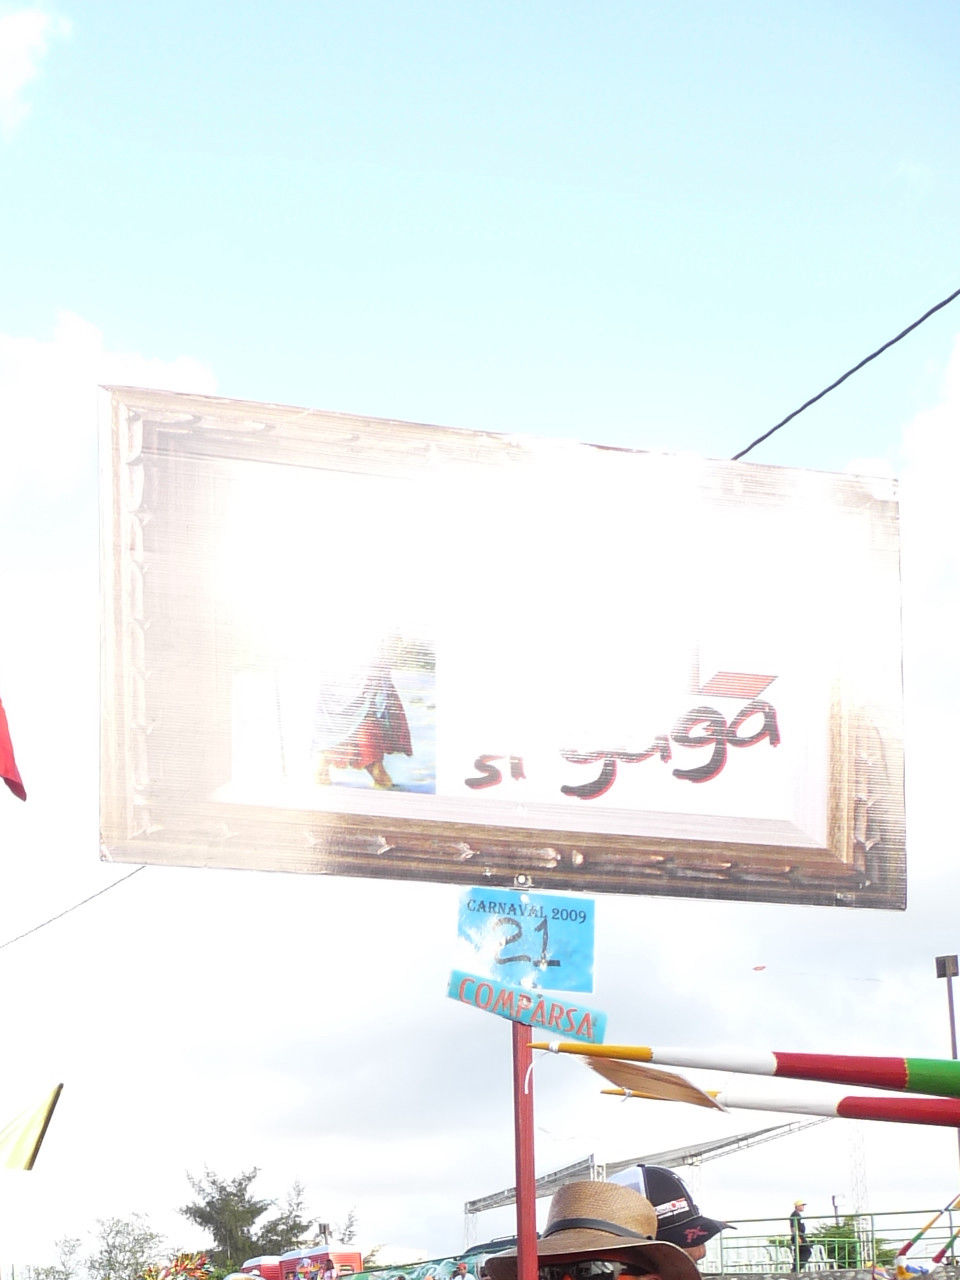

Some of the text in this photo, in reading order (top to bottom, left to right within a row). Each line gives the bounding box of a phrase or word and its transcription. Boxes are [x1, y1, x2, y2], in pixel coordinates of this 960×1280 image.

[467, 898, 587, 924] CARNAVAL 2009
[492, 917, 561, 967] 21
[457, 976, 595, 1040] COMPARSA
